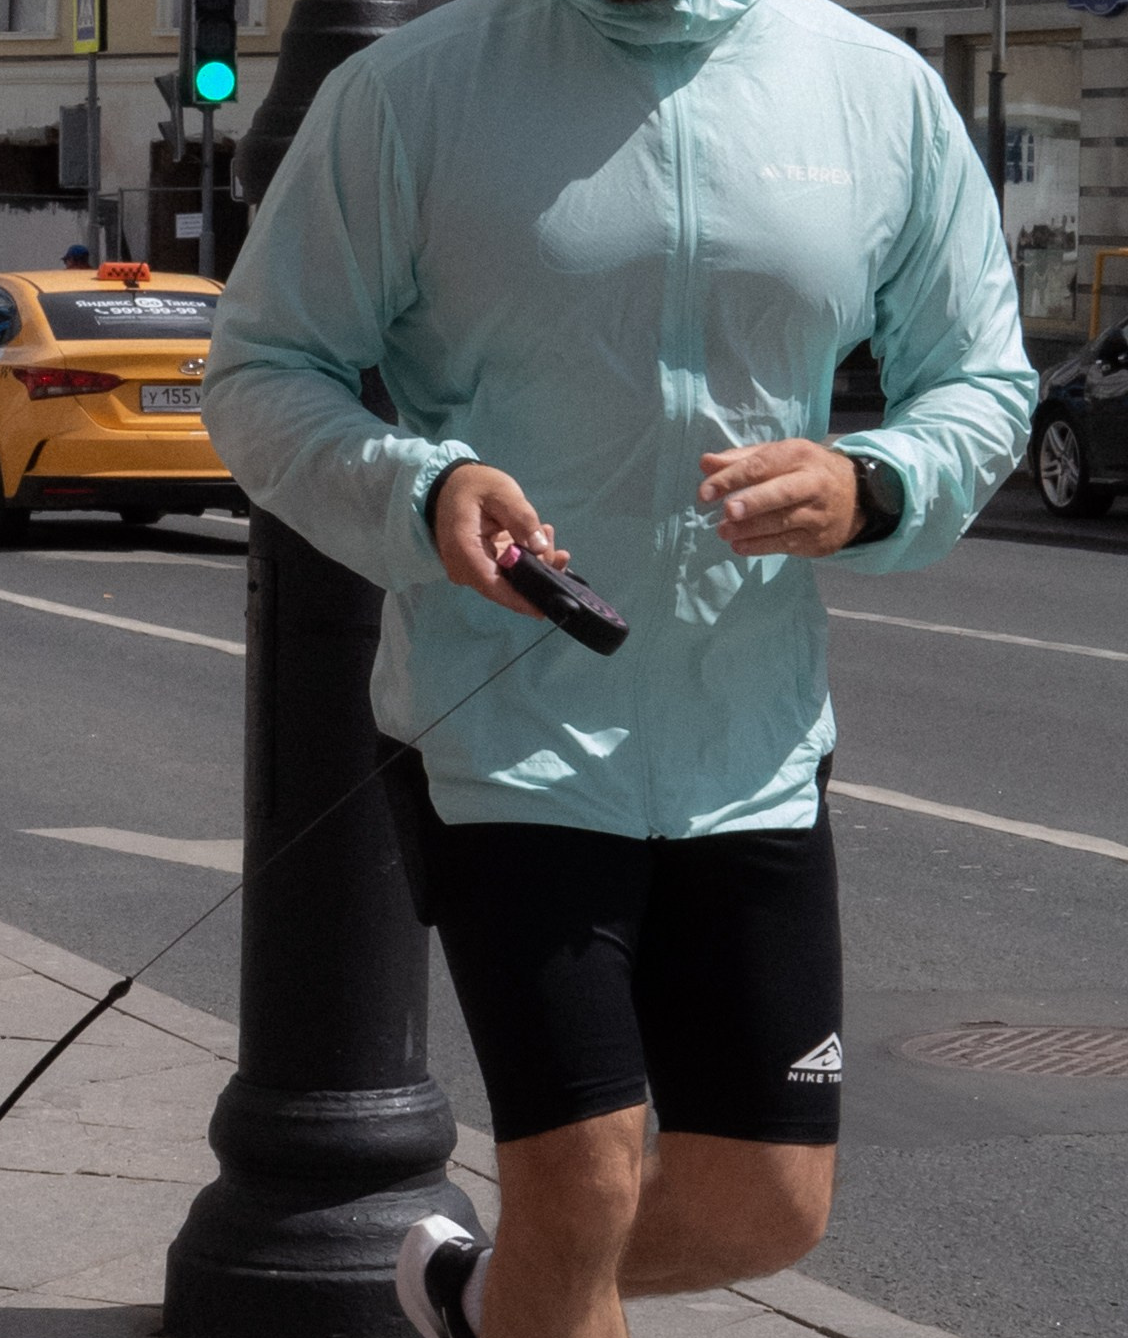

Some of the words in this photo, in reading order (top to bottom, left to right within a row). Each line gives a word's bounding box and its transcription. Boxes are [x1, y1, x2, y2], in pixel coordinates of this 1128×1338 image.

[784, 164, 853, 184] TERREX
[75, 299, 133, 308] Яндекс
[163, 299, 206, 307] Такси
[109, 307, 198, 315] 999-99-99
[788, 1071, 824, 1083] NIKE
